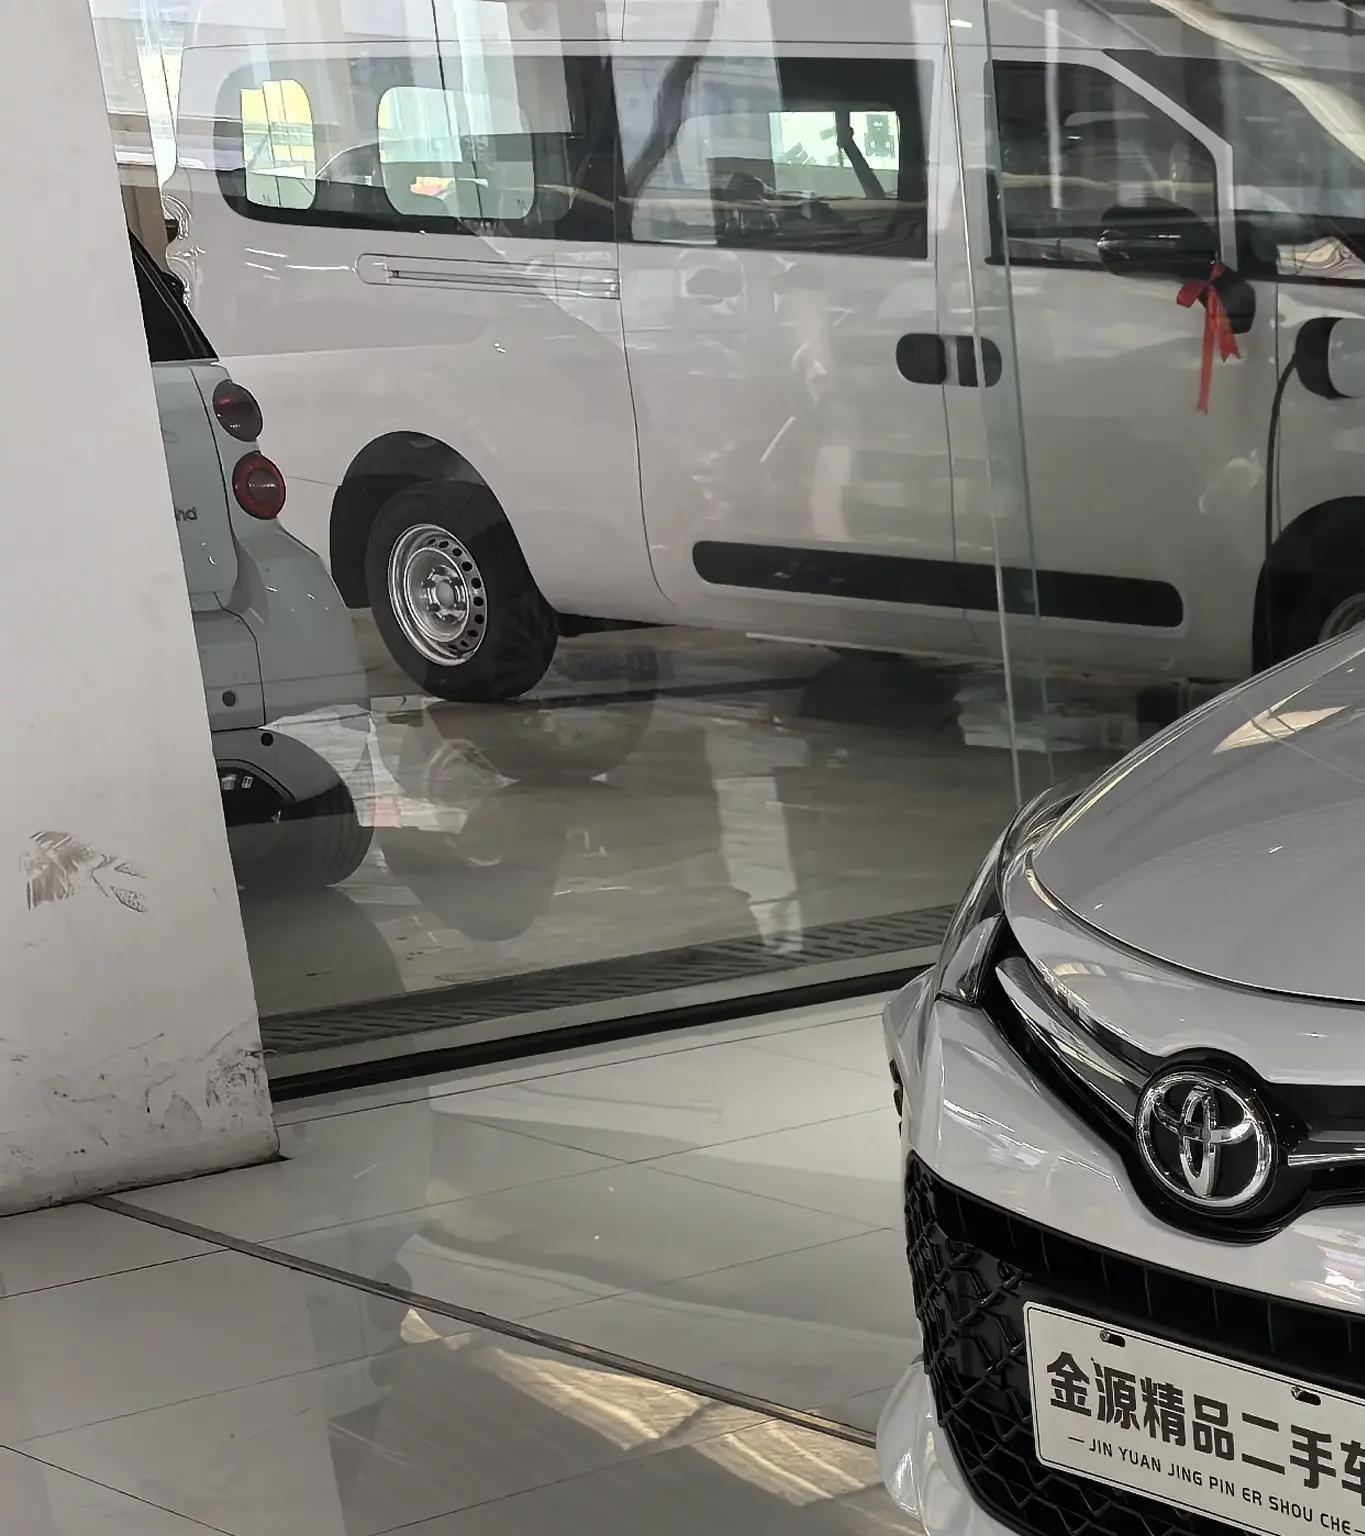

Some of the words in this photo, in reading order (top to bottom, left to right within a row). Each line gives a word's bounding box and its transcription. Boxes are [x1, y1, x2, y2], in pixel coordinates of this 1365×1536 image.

[1088, 1438, 1113, 1457] JIN
[1118, 1446, 1161, 1473] YUAN
[1167, 1463, 1203, 1486] JING
[1209, 1476, 1235, 1497] PIN
[1242, 1487, 1263, 1506] ER
[1268, 1496, 1314, 1522] SHOU
[1320, 1513, 1351, 1535] CHE
